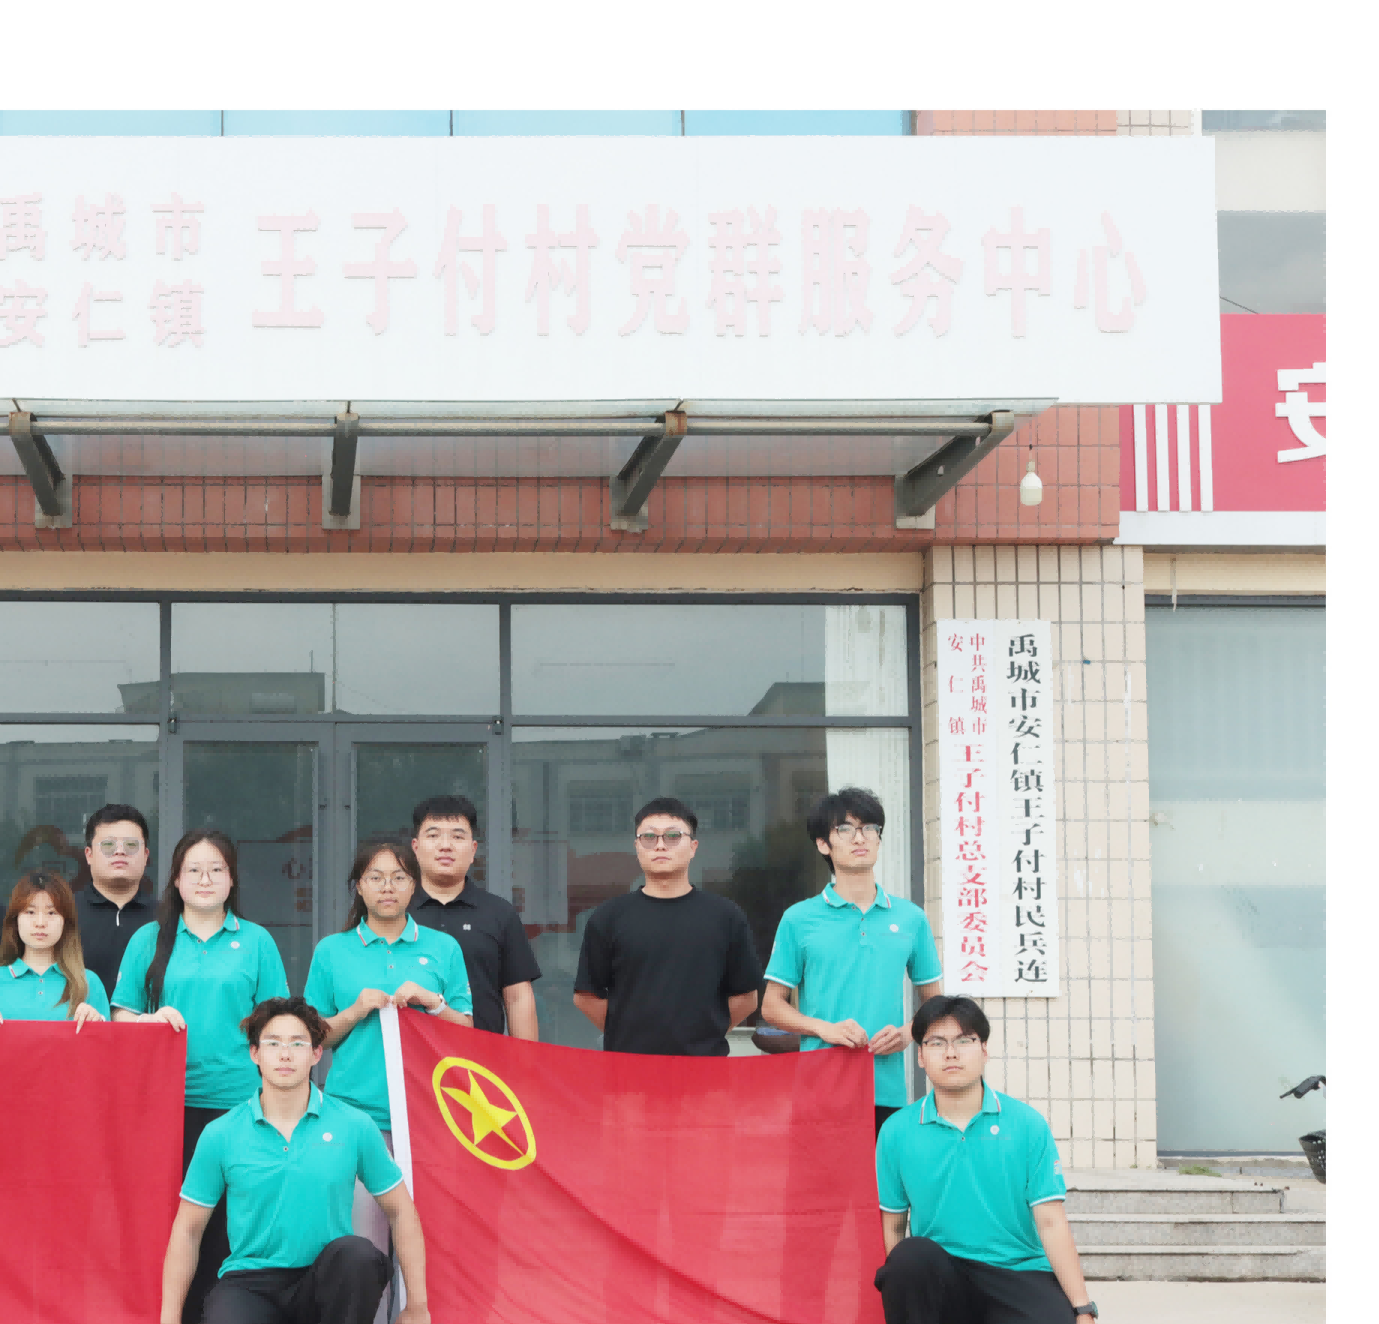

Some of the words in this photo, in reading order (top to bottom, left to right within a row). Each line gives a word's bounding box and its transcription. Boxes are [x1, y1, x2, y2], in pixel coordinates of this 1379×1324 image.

[252, 203, 1147, 338] 王子付村党群服务中心
[953, 744, 989, 983] 王子付村总支部委员会
[1006, 633, 1048, 984] 禹城市安仁镇王子付村民兵连
